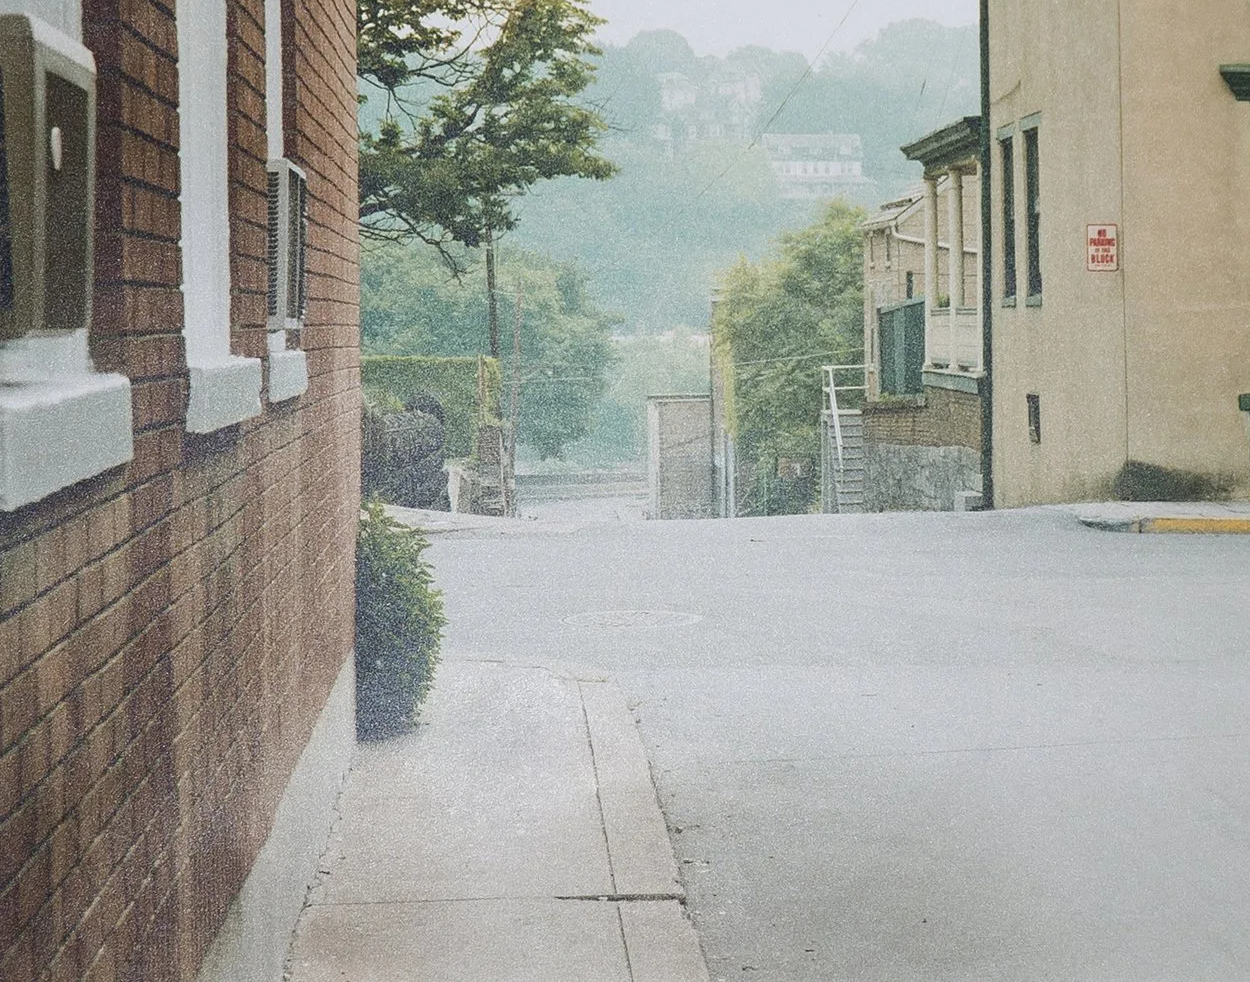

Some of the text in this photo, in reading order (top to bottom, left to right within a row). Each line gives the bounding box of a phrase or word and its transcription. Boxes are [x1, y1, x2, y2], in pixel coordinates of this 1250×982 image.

[1097, 229, 1106, 237] NO
[1090, 238, 1115, 246] PARKING
[1091, 254, 1115, 263] BLOCK
